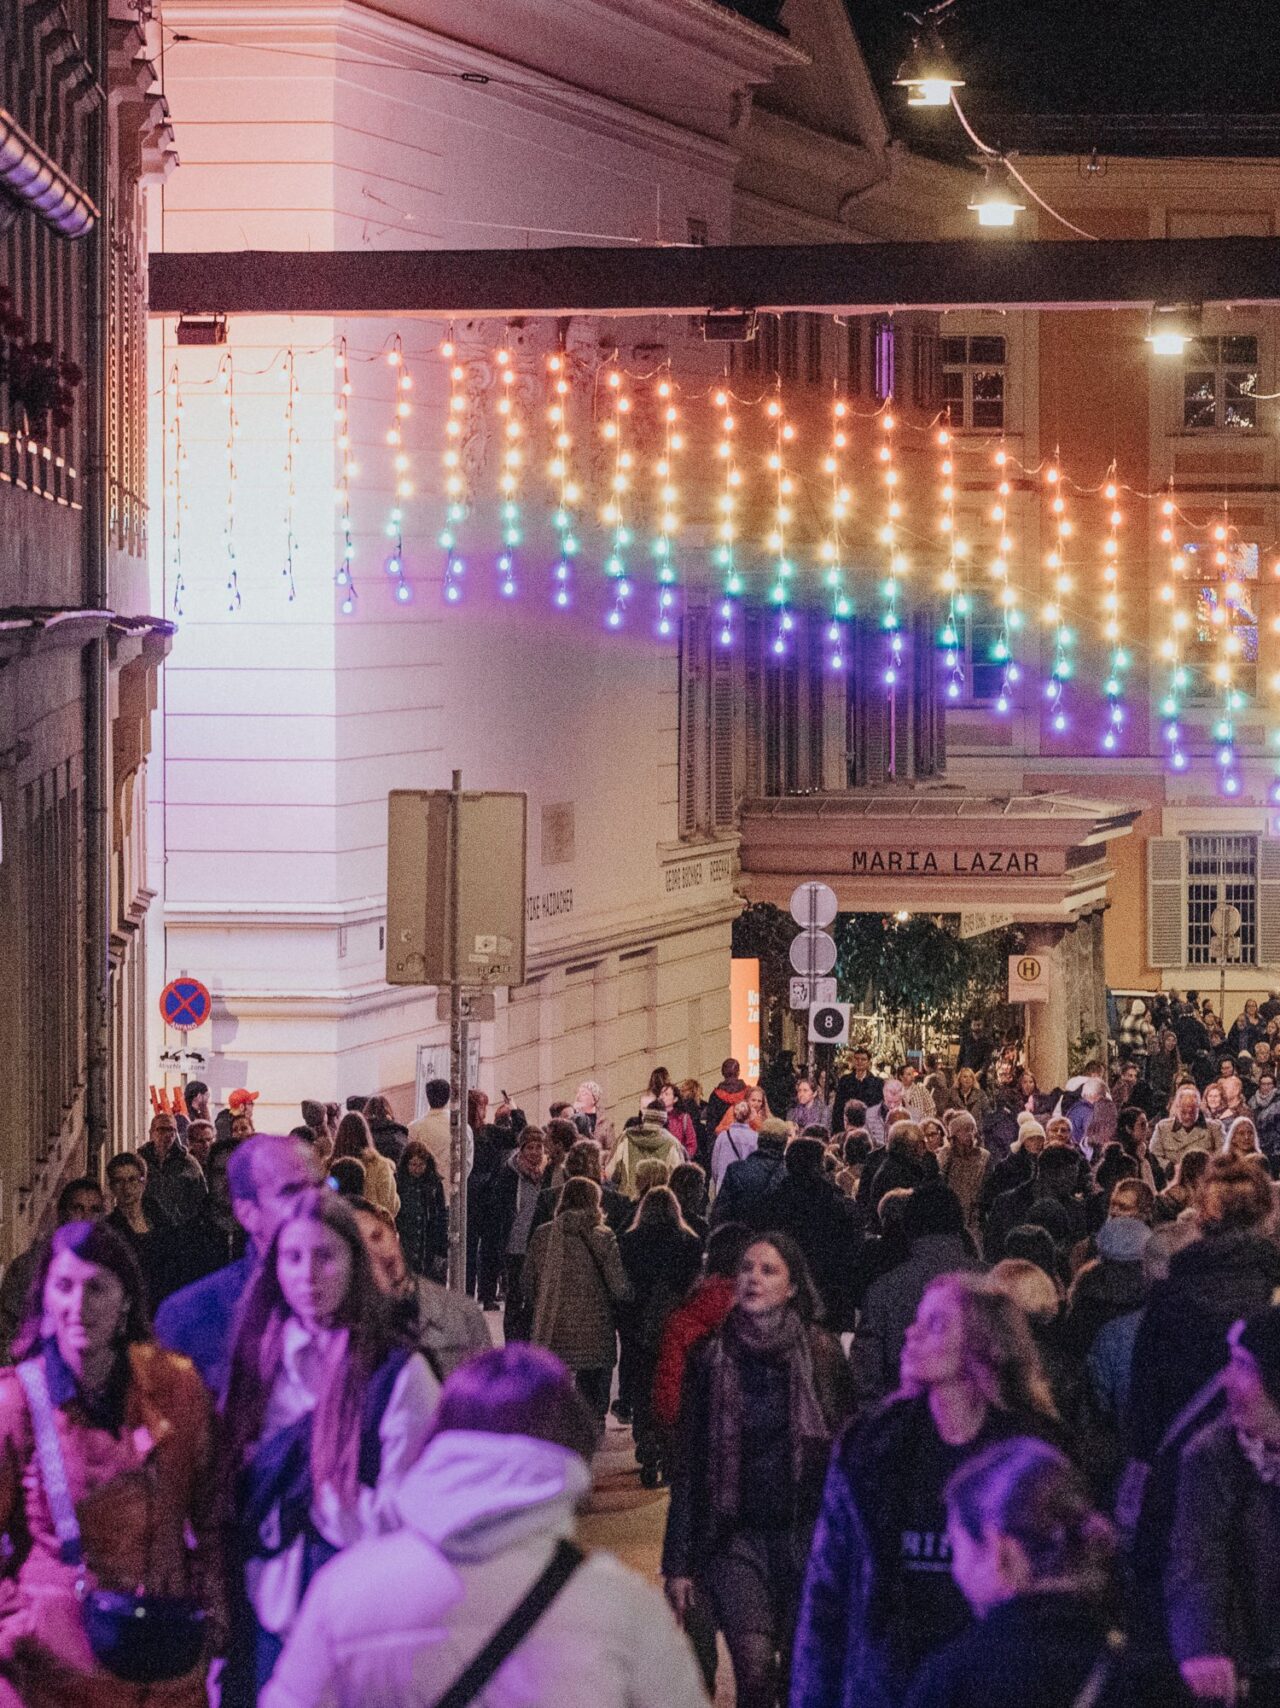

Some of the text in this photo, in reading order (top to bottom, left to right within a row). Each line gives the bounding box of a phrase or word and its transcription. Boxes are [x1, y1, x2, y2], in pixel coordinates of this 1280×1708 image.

[852, 851, 1039, 872] MARIA LAZAR
[1023, 962, 1035, 976] H
[824, 1015, 833, 1028] 8
